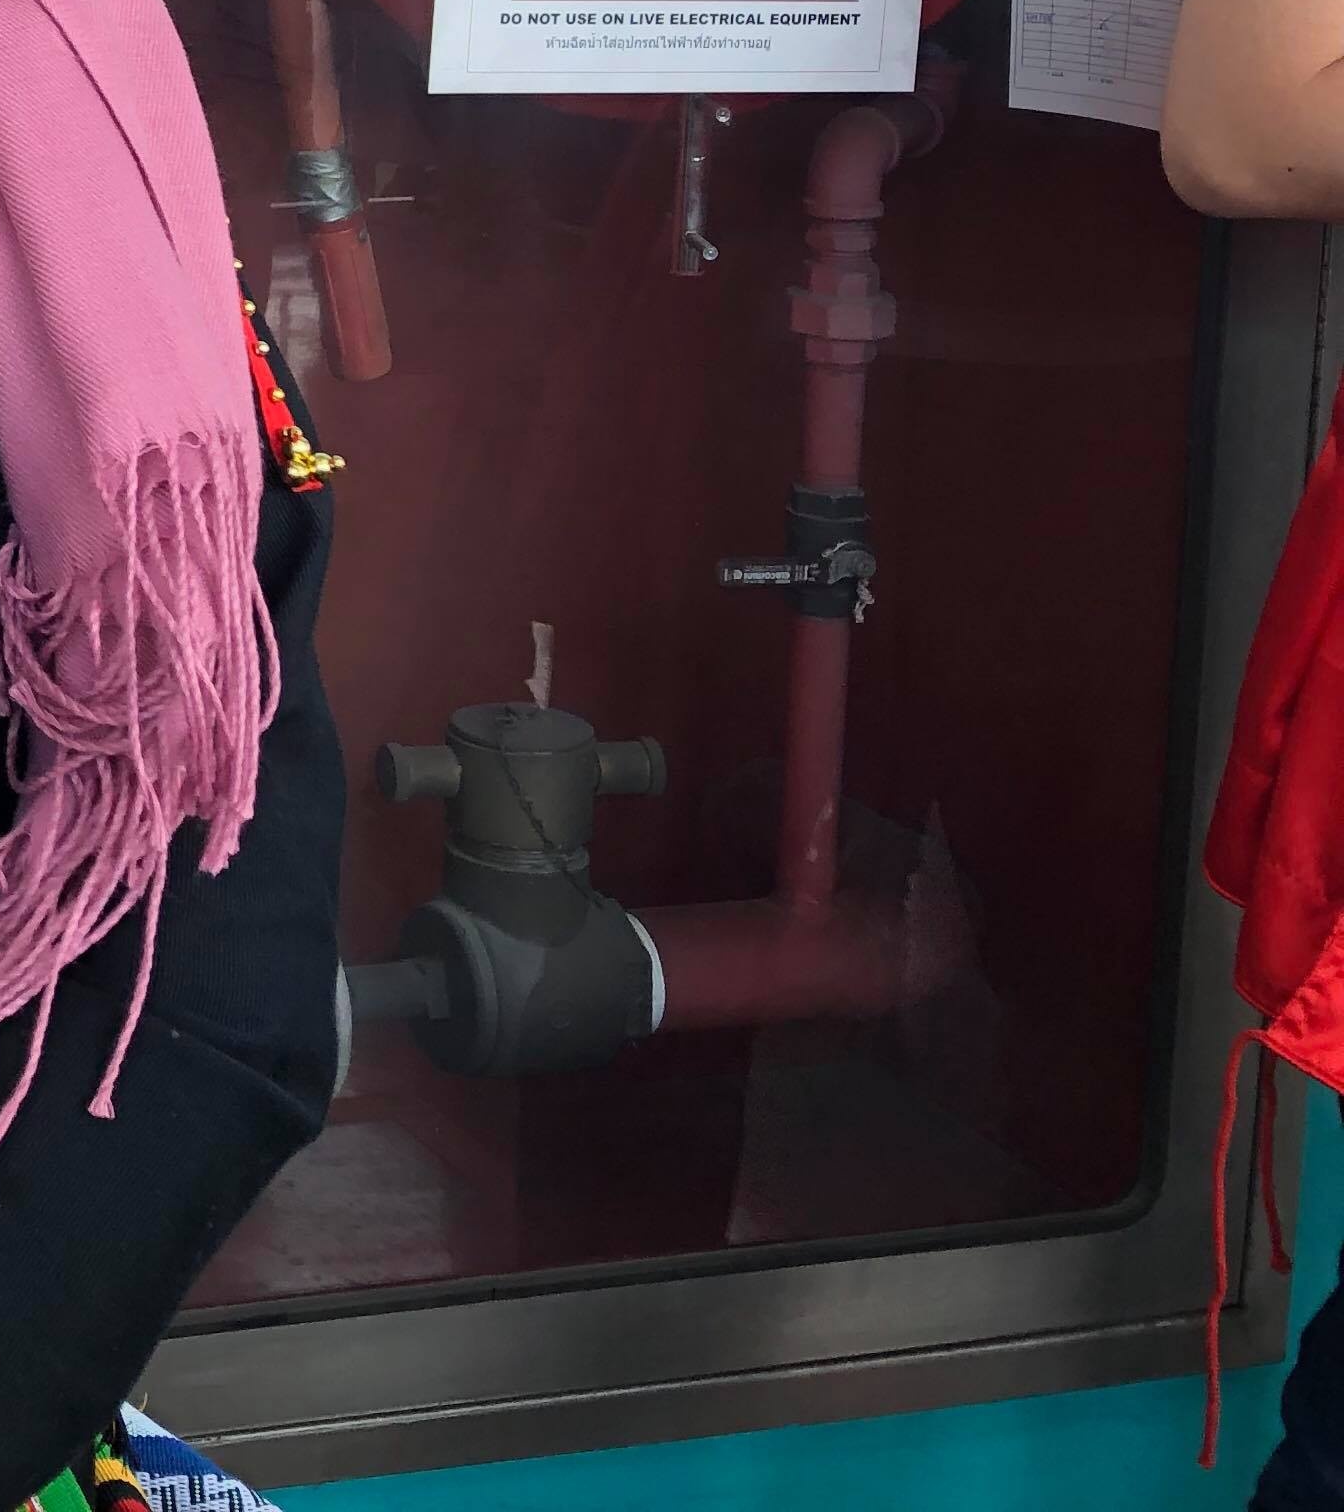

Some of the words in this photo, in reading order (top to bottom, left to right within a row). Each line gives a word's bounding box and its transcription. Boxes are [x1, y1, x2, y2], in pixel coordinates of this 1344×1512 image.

[500, 13, 522, 25] DO
[528, 13, 560, 25] NOT
[566, 13, 597, 25] USE
[602, 13, 625, 25] ON
[630, 13, 664, 25] LIVE
[670, 13, 765, 25] ELECTRICAL
[770, 13, 861, 26] EQUIPMENT
